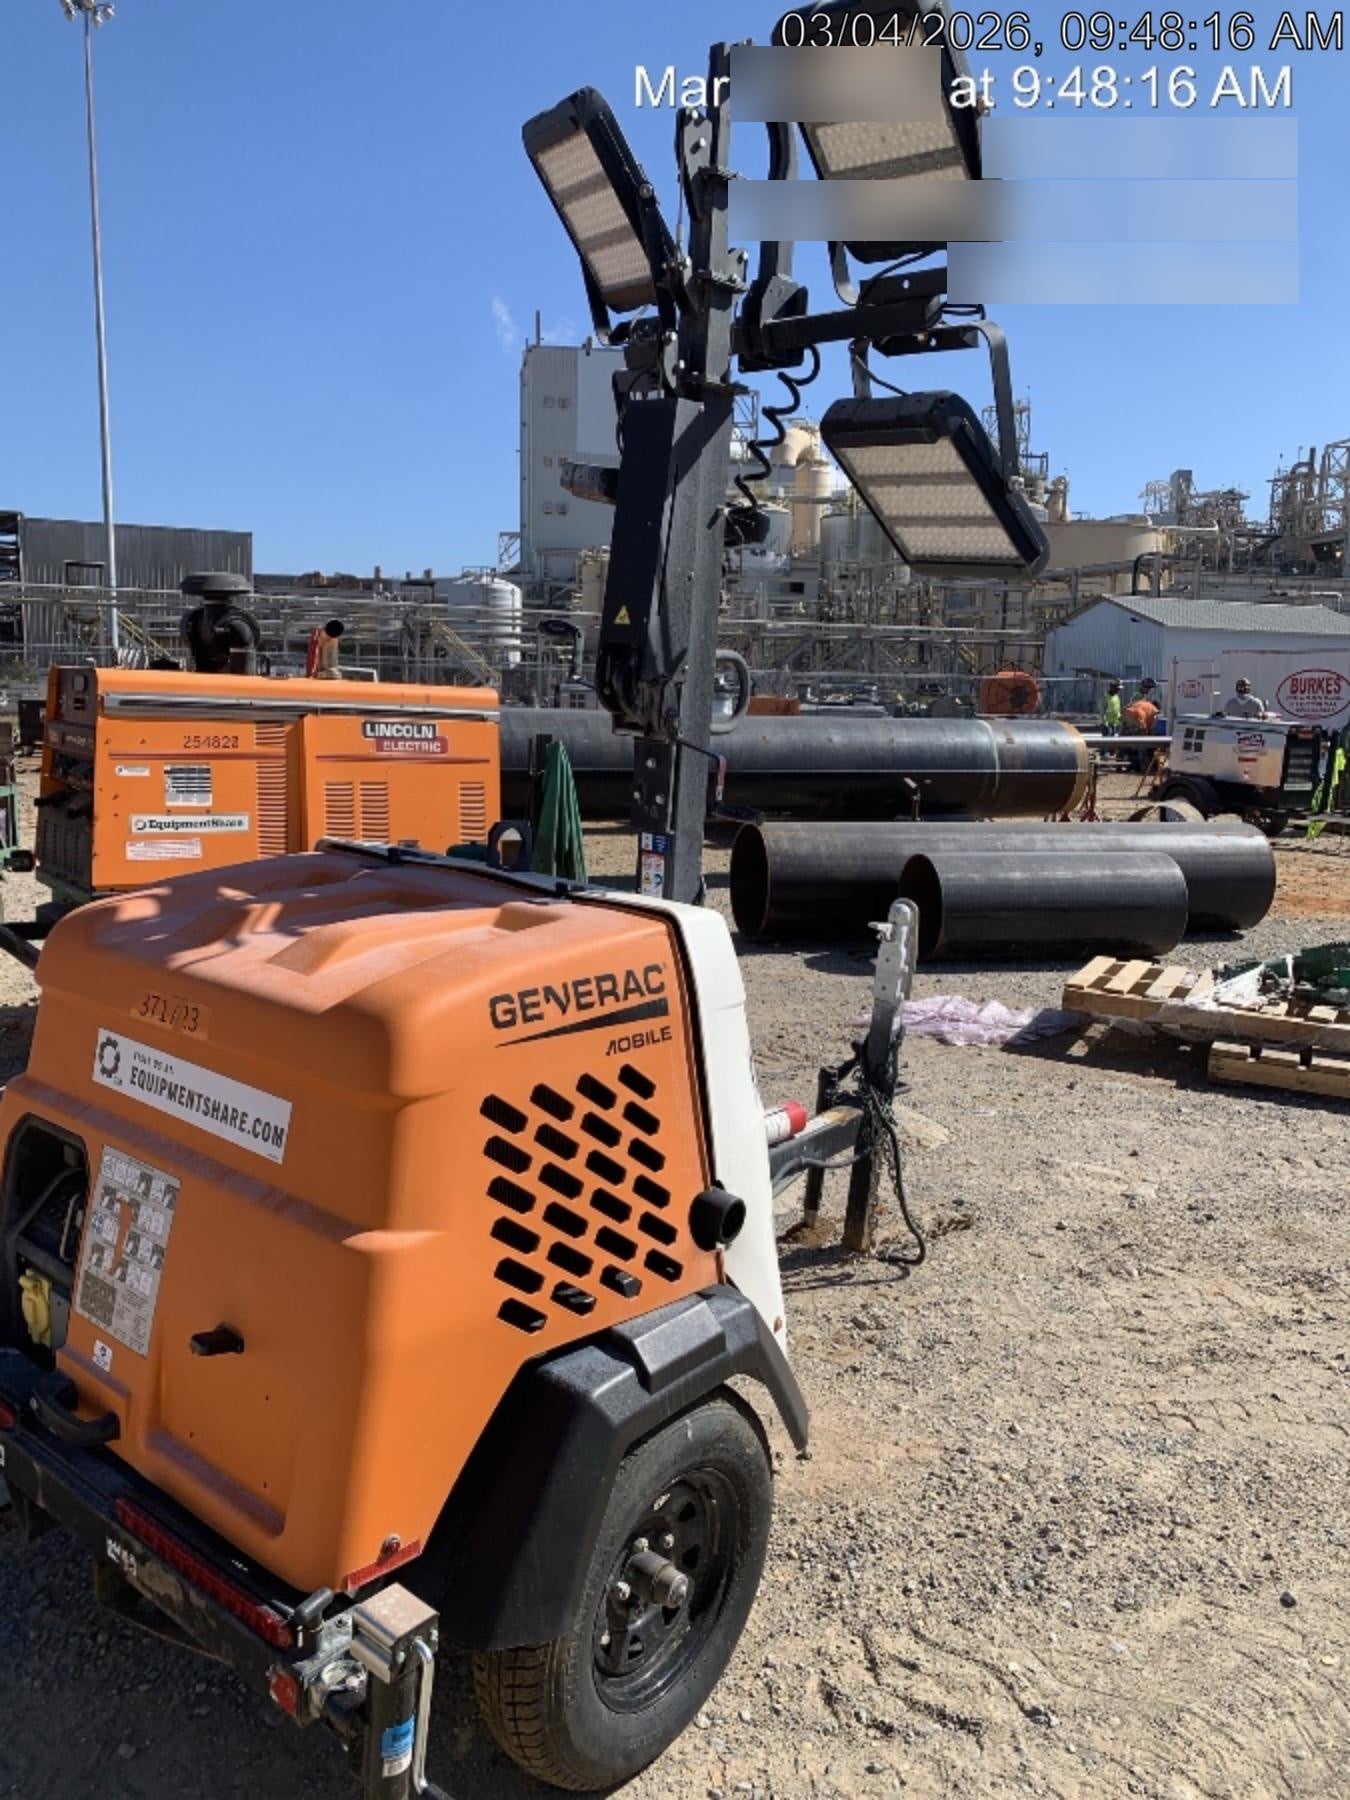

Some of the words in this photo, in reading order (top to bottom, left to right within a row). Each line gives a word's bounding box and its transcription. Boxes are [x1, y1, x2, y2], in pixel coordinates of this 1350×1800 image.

[1290, 677, 1342, 695] BURKES
[365, 722, 434, 739] LINCOLN
[383, 740, 441, 753] ELECTRIC
[488, 963, 666, 1030] GENERAC
[605, 1025, 673, 1056] MOBILE
[129, 1066, 285, 1149] EQUIPMENTSHARE.COM
